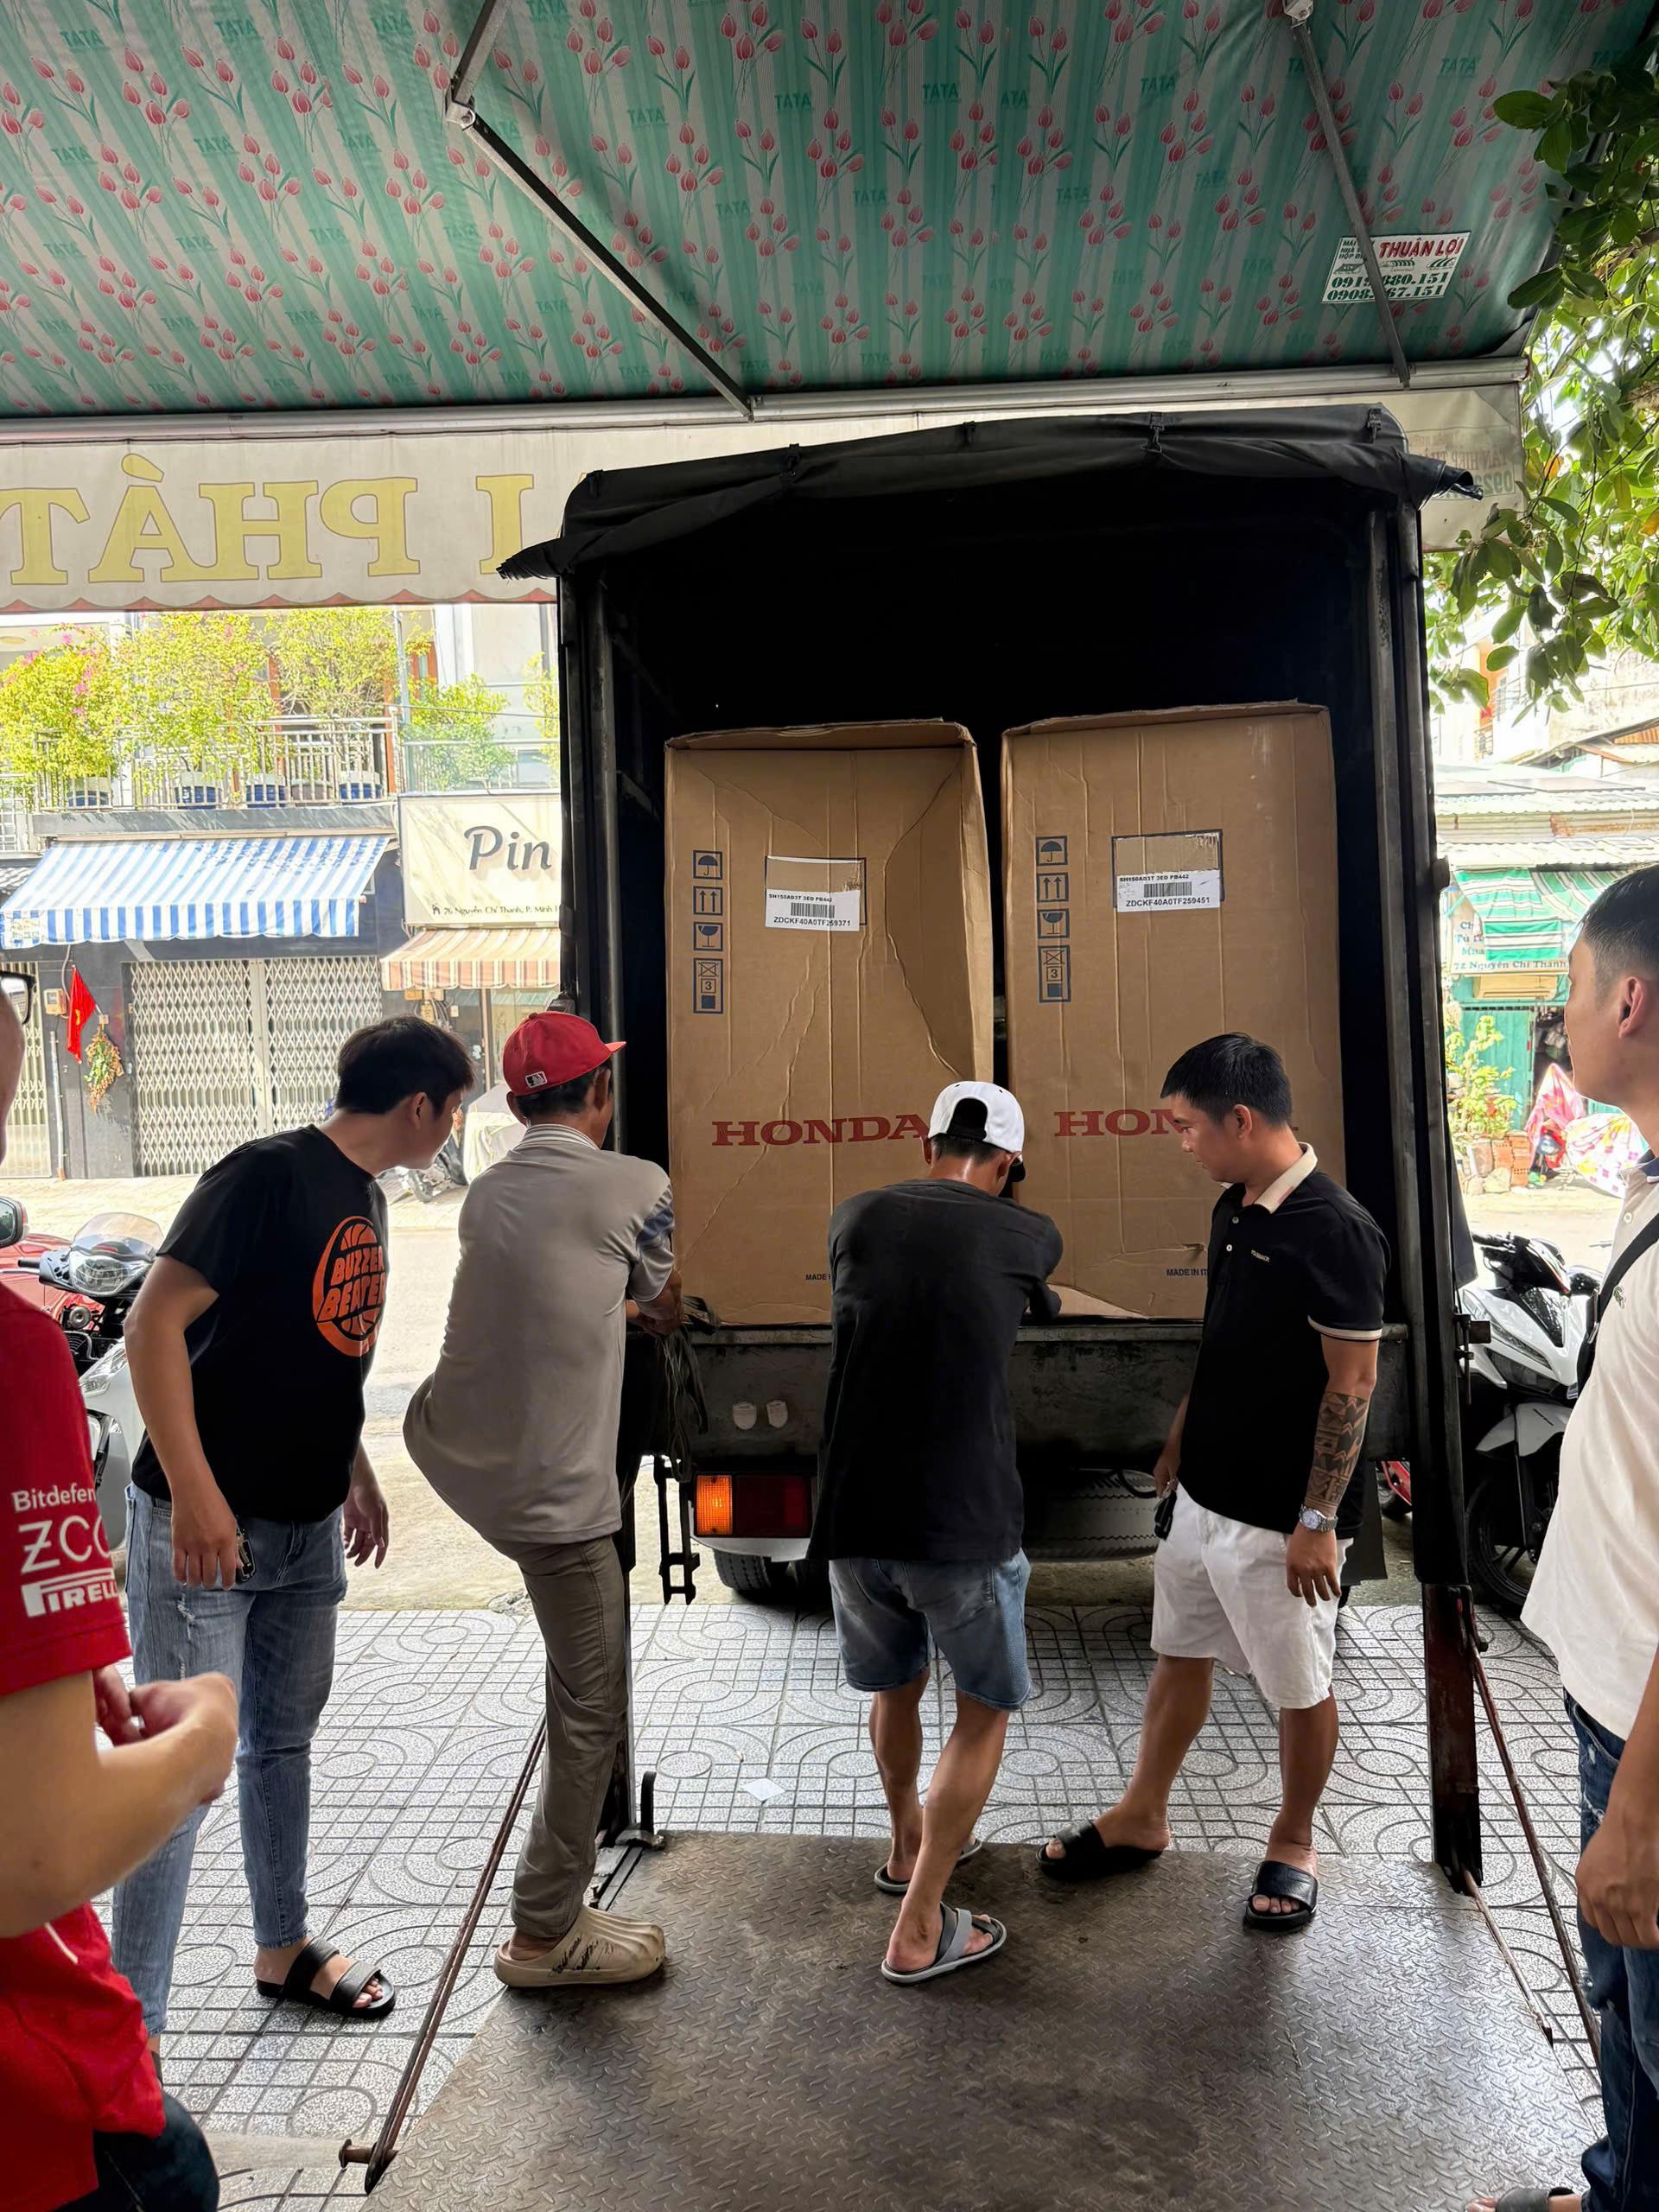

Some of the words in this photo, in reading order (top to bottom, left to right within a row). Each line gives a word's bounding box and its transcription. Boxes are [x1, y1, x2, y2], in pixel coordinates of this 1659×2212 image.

[216, 18, 258, 37] TATA
[60, 28, 105, 49] TATA
[1440, 57, 1478, 76] TATA
[922, 82, 958, 99] TATA
[1141, 75, 1176, 94] TATA
[774, 93, 812, 111] TATA
[627, 109, 665, 124] TATA
[194, 136, 236, 154] TATA
[52, 146, 93, 165] TATA
[853, 189, 887, 205] TATA
[1056, 188, 1091, 202] TATA
[715, 200, 750, 216] TATA
[175, 235, 213, 251] TATA
[309, 228, 347, 242] TATA
[43, 241, 81, 257] TATA
[536, 300, 569, 314] TATA
[161, 317, 199, 331] TATA
[285, 310, 321, 325] TATA
[464, 825, 552, 871] Pin
[1051, 969, 1058, 979] 3
[705, 981, 712, 991] 3
[712, 1114, 931, 1147] HONDA
[1054, 1109, 1185, 1138] HON
[12, 1483, 96, 1512] Bitdefen
[21, 1567, 119, 1618] PIRELL
